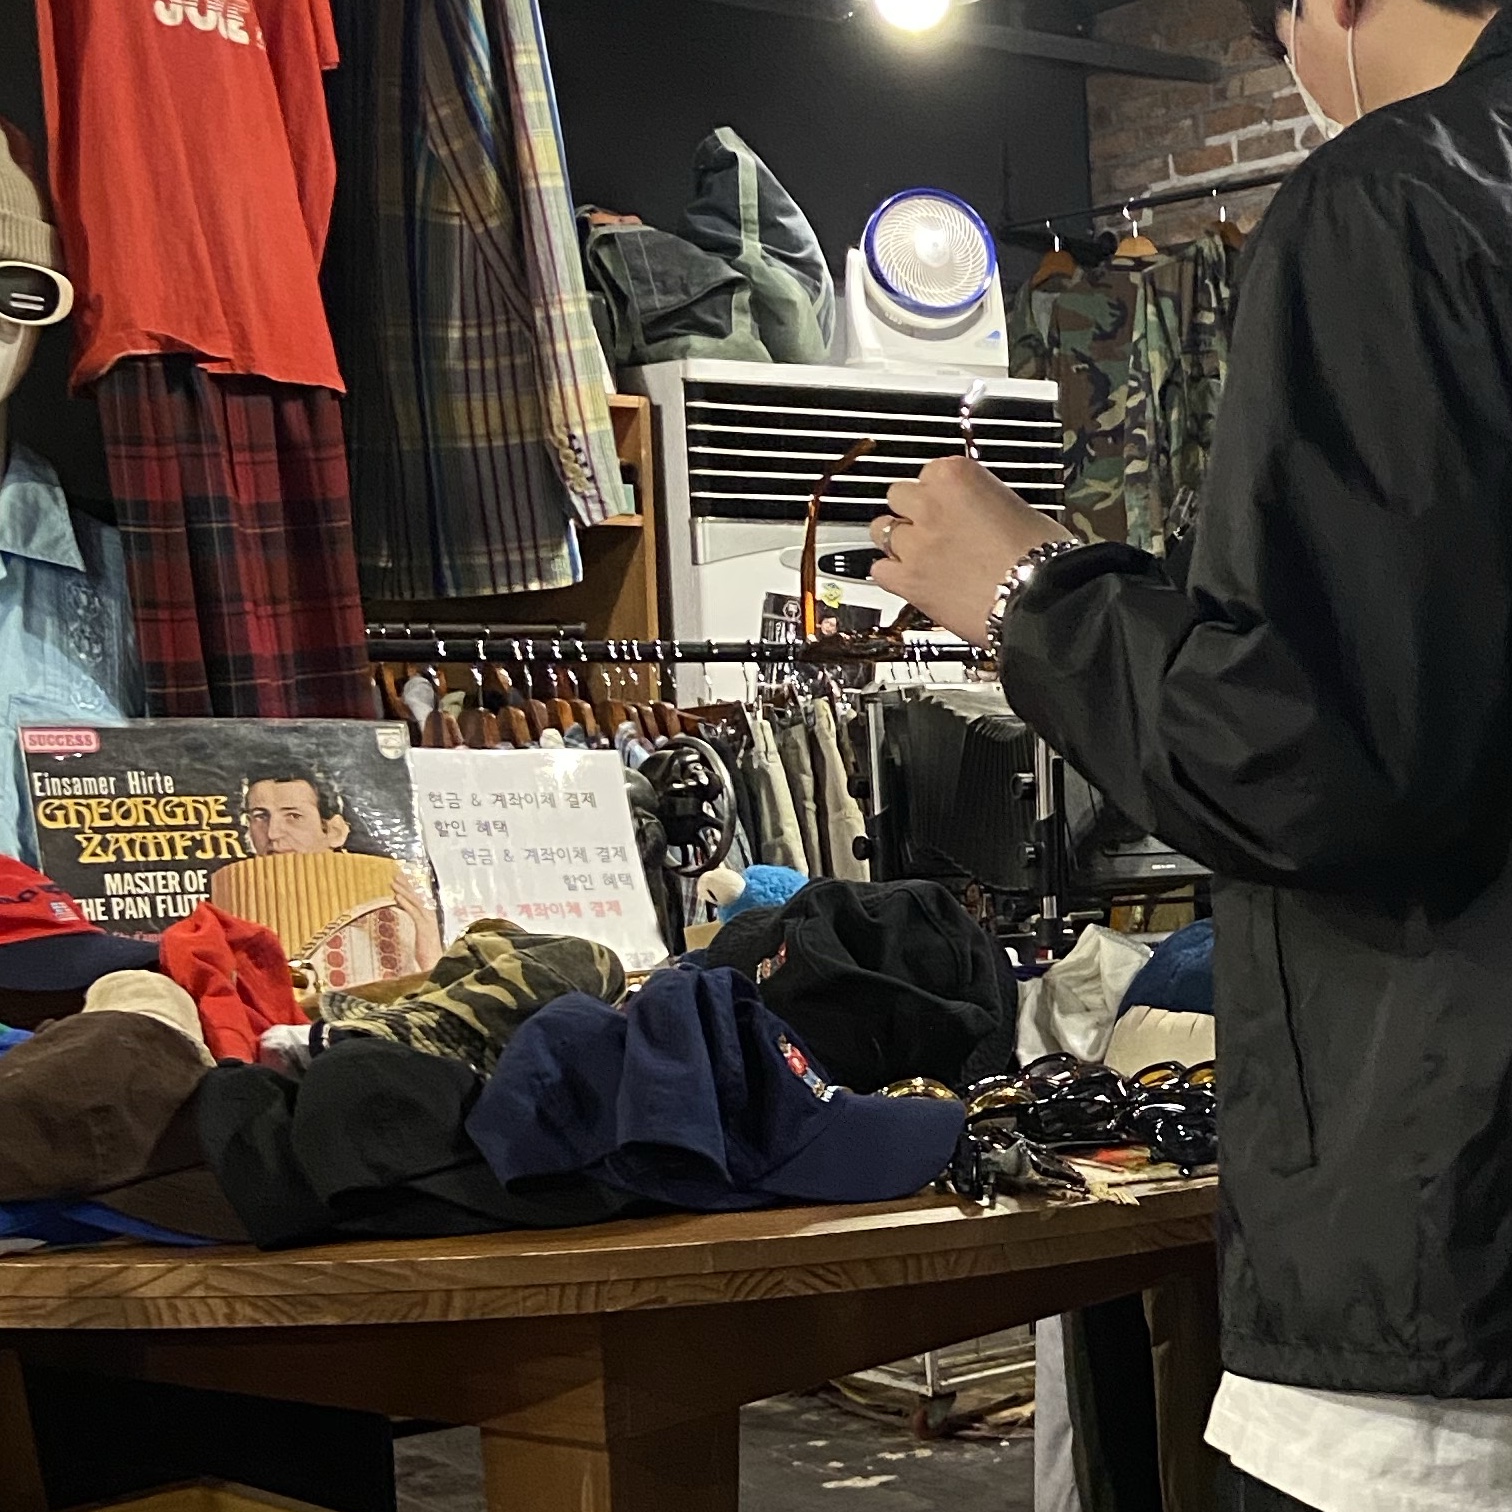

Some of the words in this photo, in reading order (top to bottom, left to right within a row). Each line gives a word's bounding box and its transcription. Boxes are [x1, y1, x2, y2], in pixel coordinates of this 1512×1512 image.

[28, 733, 94, 747] SUCCESS
[32, 772, 117, 797] Einsamer
[126, 771, 175, 795] Hirte
[428, 791, 463, 809] 현금
[471, 793, 482, 807] &
[491, 791, 557, 809] 계좌이체
[565, 791, 598, 809] 결제
[434, 819, 468, 837] 할인
[475, 819, 510, 837] 혜택
[461, 848, 494, 866] 현금
[503, 849, 514, 863] &
[524, 846, 589, 864] 계좌이체
[597, 846, 628, 863] 결제
[103, 870, 180, 896] MASTER
[184, 869, 208, 893] OF
[562, 873, 595, 891] 할인
[603, 872, 635, 890] 혜택
[111, 896, 151, 920] PAN
[156, 893, 210, 919] FLUT
